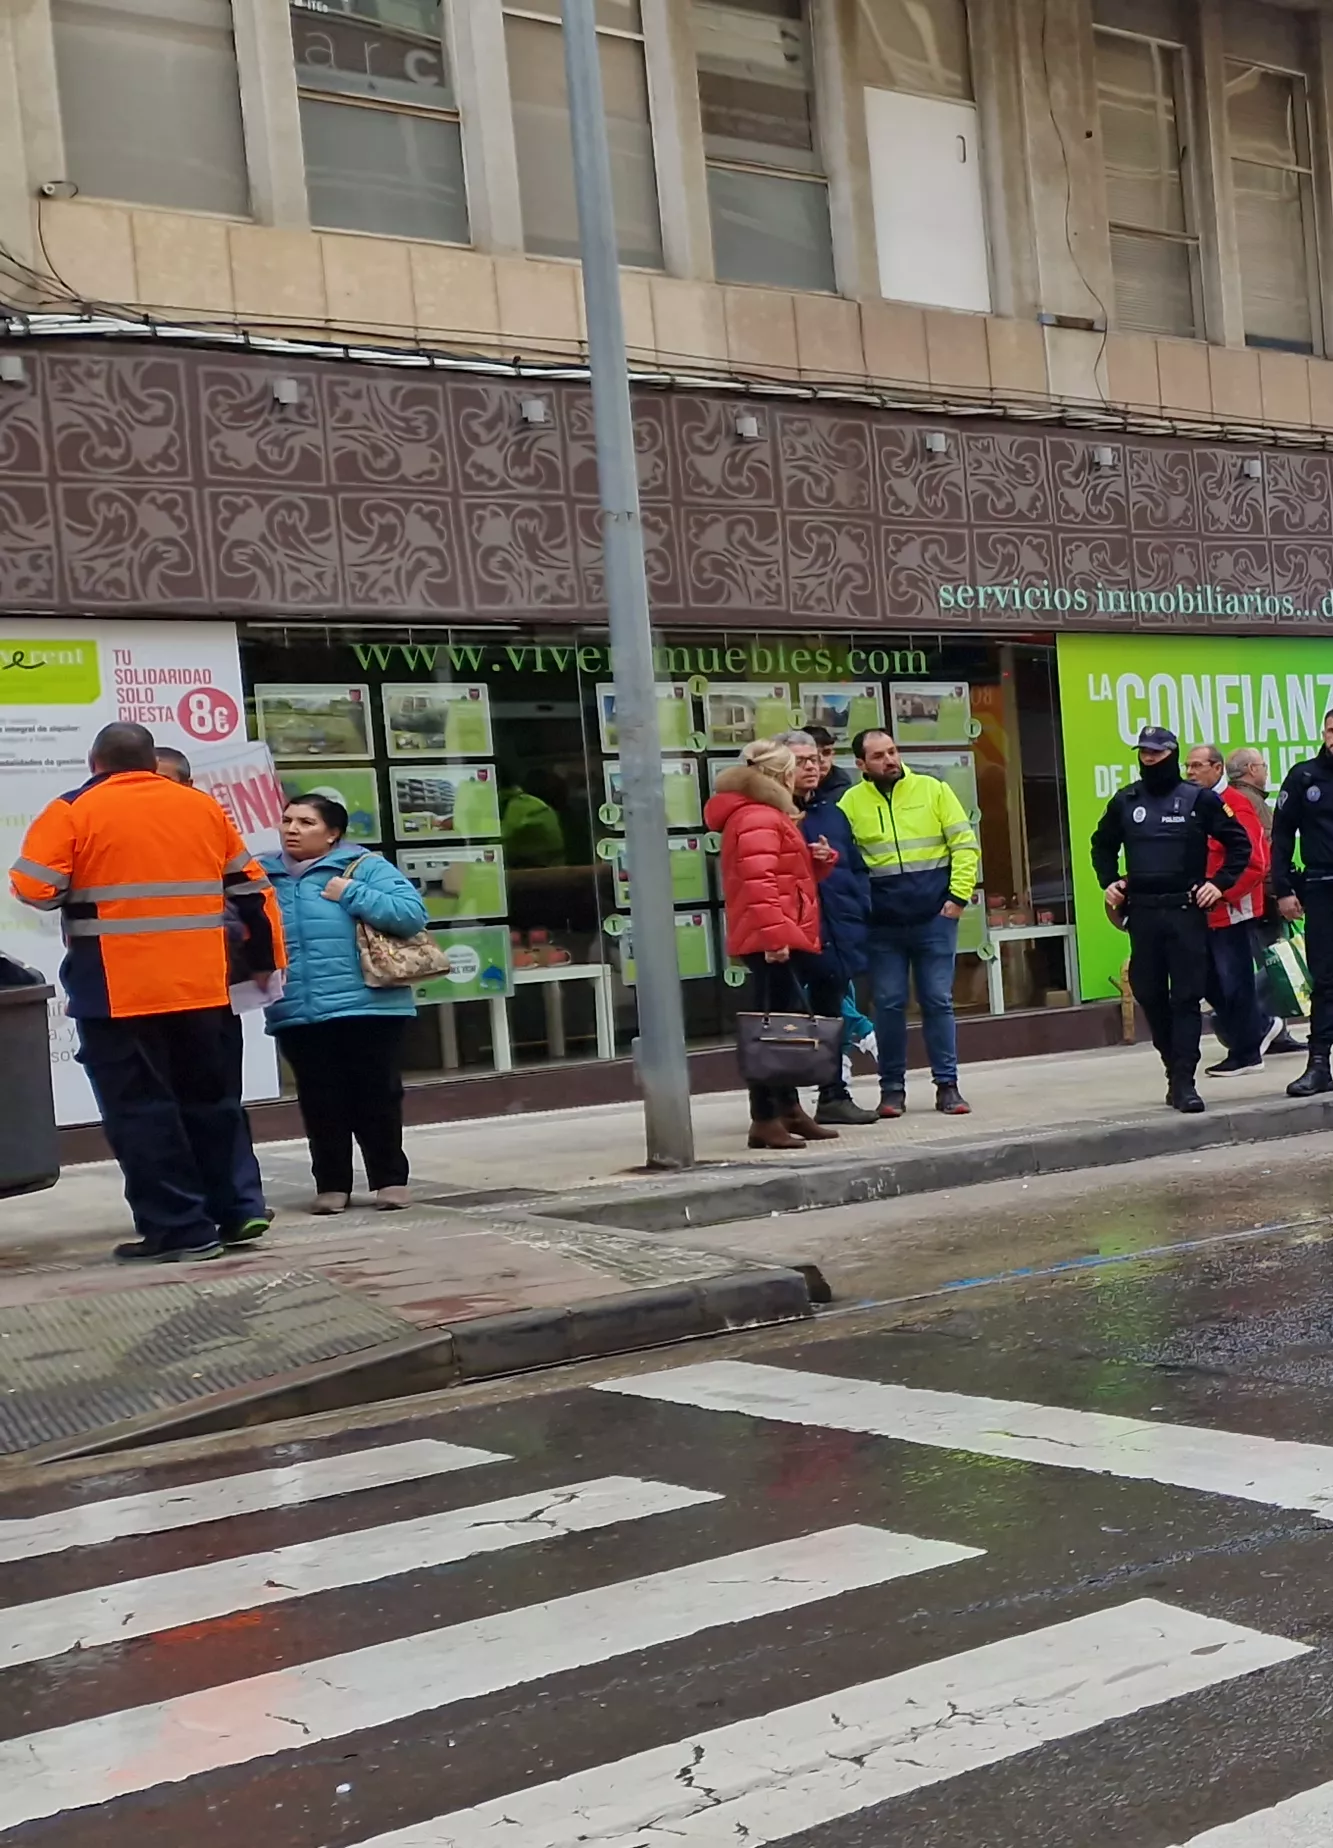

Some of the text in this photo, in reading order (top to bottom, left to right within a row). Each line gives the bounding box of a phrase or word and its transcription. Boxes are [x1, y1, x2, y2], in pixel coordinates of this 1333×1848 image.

[939, 579, 1088, 613] servicios
[113, 649, 132, 666] TU
[115, 668, 212, 685] SOLIDARIDAD
[117, 687, 154, 704] SOLO
[1088, 673, 1113, 701] LA
[118, 705, 175, 723] CUESTA
[1095, 765, 1122, 798] DE
